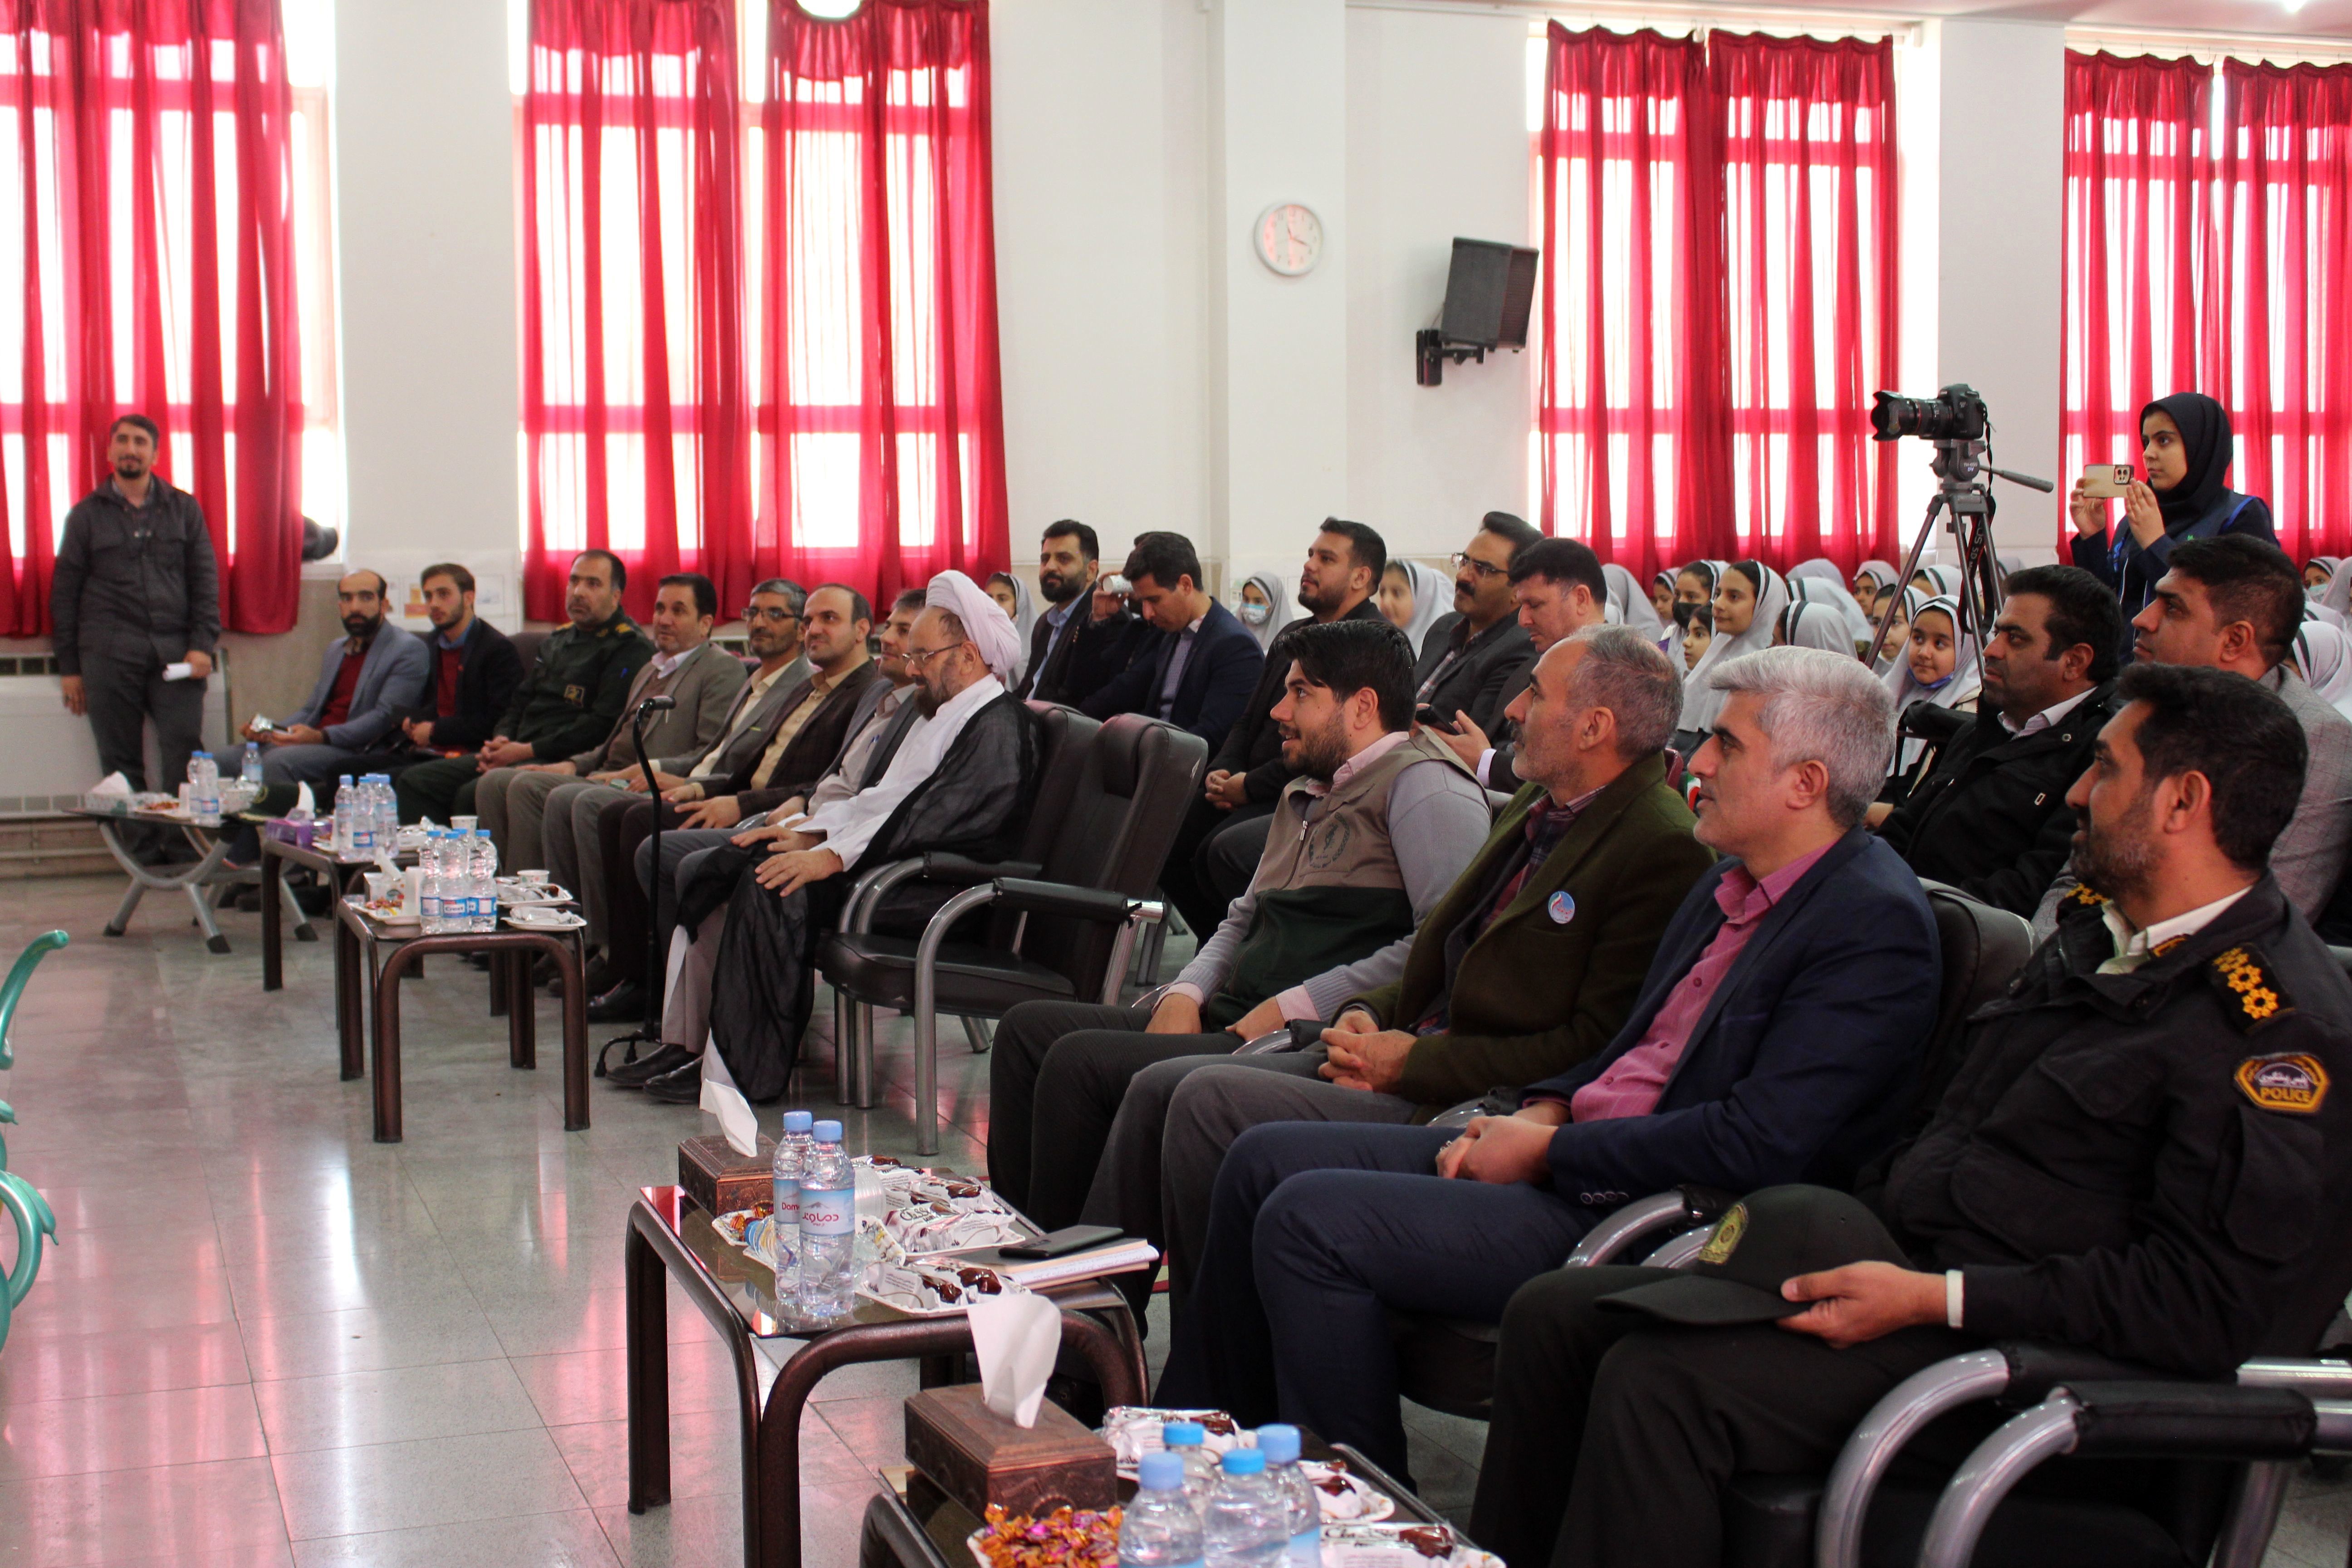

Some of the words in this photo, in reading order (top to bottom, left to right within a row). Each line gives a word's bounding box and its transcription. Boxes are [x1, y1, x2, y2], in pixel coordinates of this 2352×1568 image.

[2260, 1087, 2311, 1102] POLICE
[782, 1202, 799, 1210] Dam
[802, 1212, 839, 1223] دماوند
